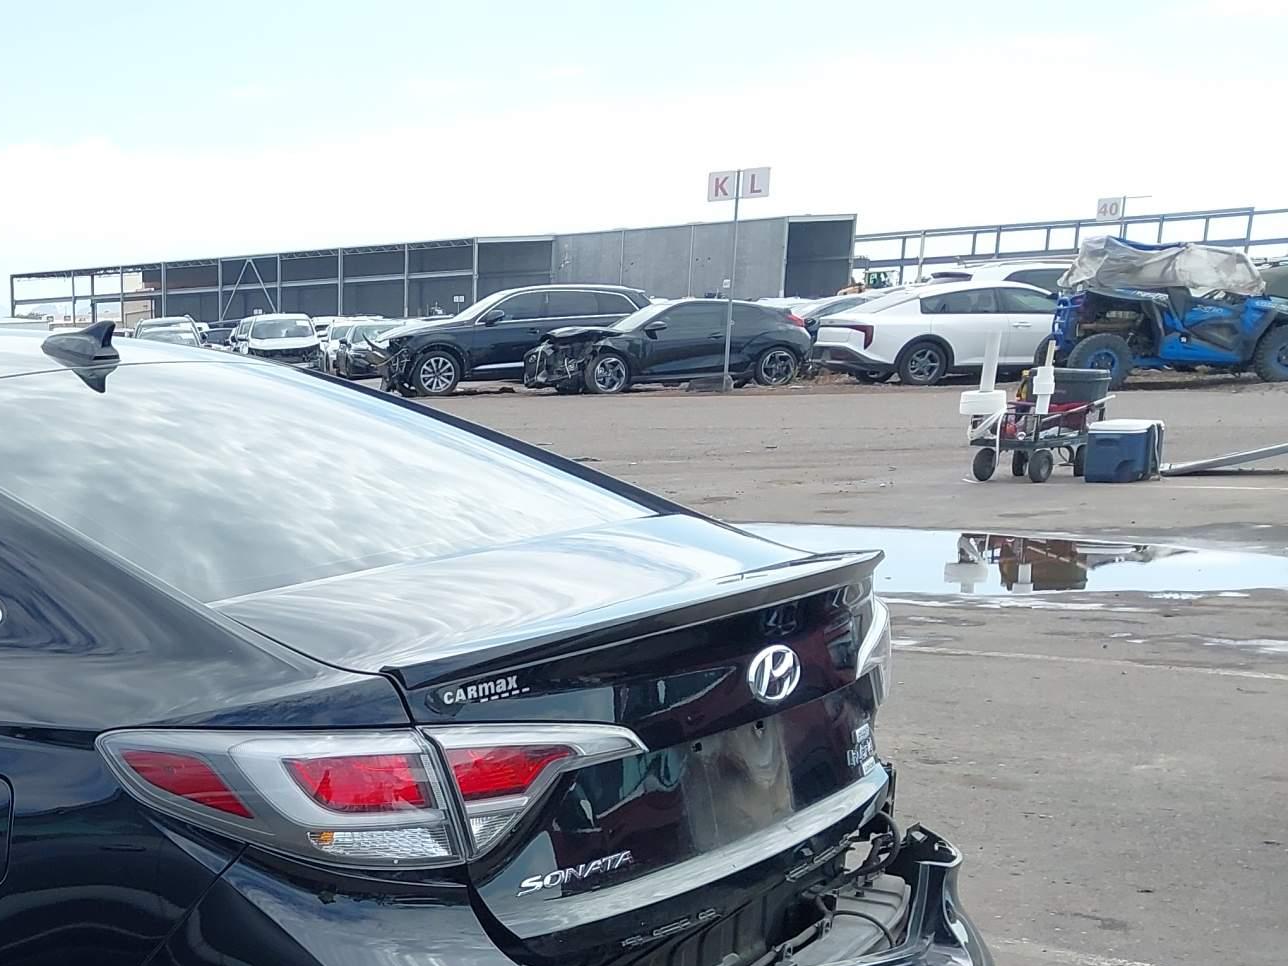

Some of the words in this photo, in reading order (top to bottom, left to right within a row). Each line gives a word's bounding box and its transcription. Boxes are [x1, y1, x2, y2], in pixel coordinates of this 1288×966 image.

[714, 176, 729, 197] K
[750, 173, 762, 194] L
[1098, 202, 1119, 217] 40
[516, 850, 633, 897] SONATA
